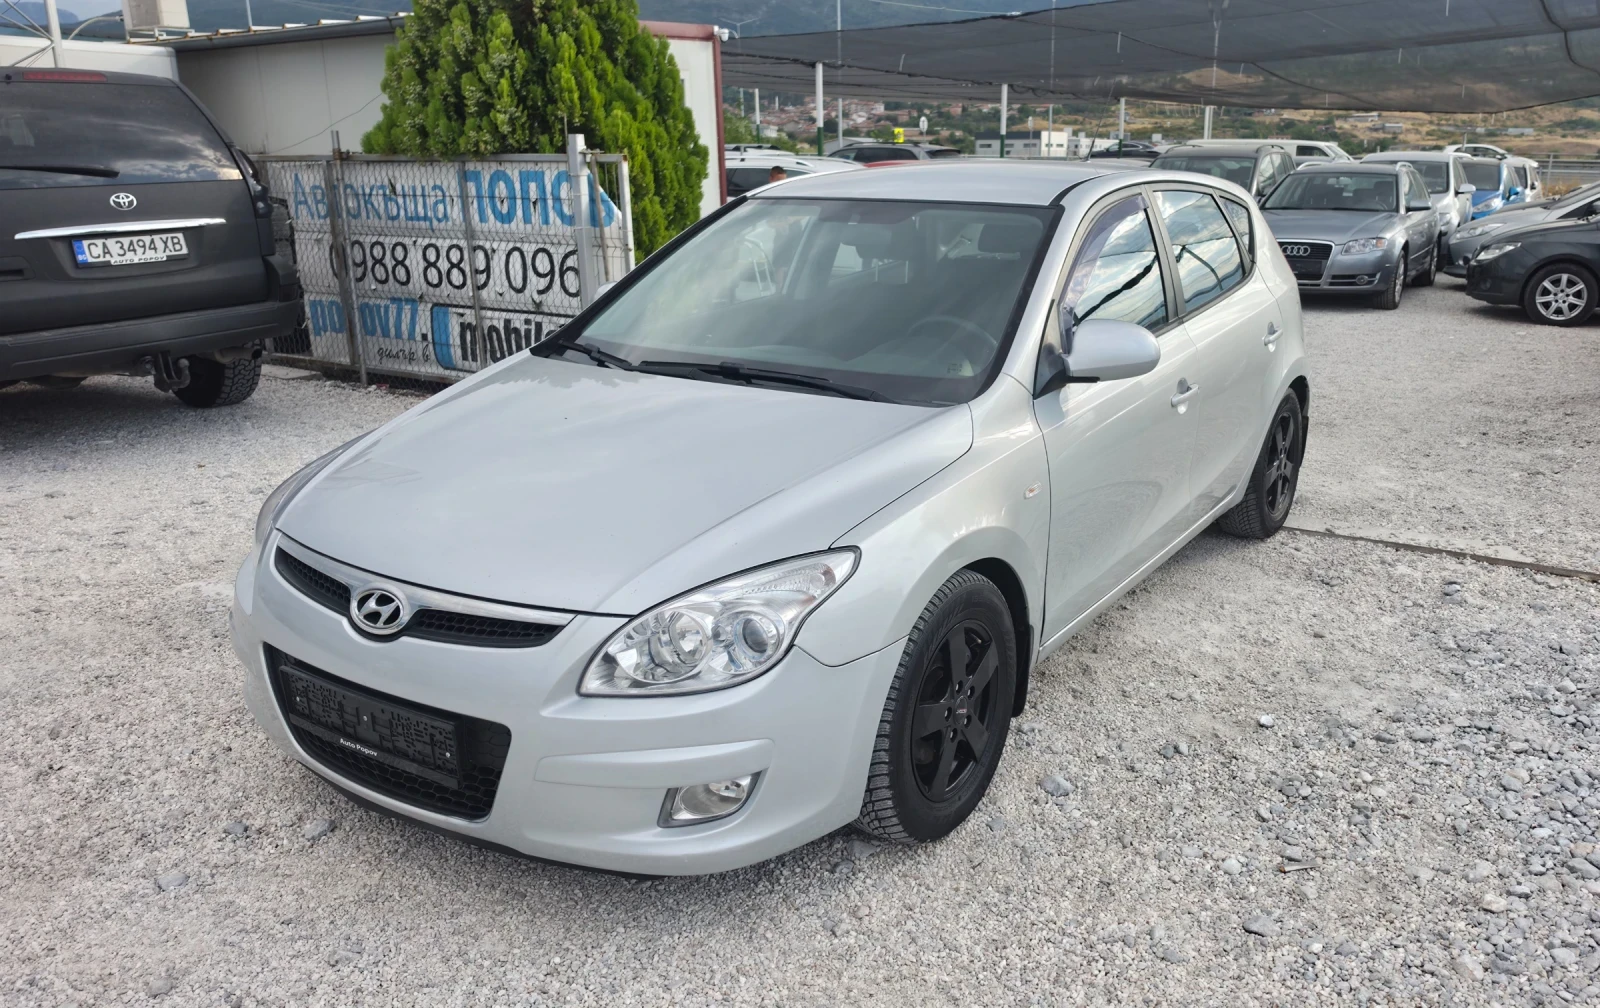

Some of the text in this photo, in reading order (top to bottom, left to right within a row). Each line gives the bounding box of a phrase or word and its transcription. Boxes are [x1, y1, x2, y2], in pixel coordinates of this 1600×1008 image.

[422, 243, 490, 290] 889
[505, 246, 580, 298] 096
[459, 318, 557, 363] mobil
[340, 738, 377, 756] Auto Popov
